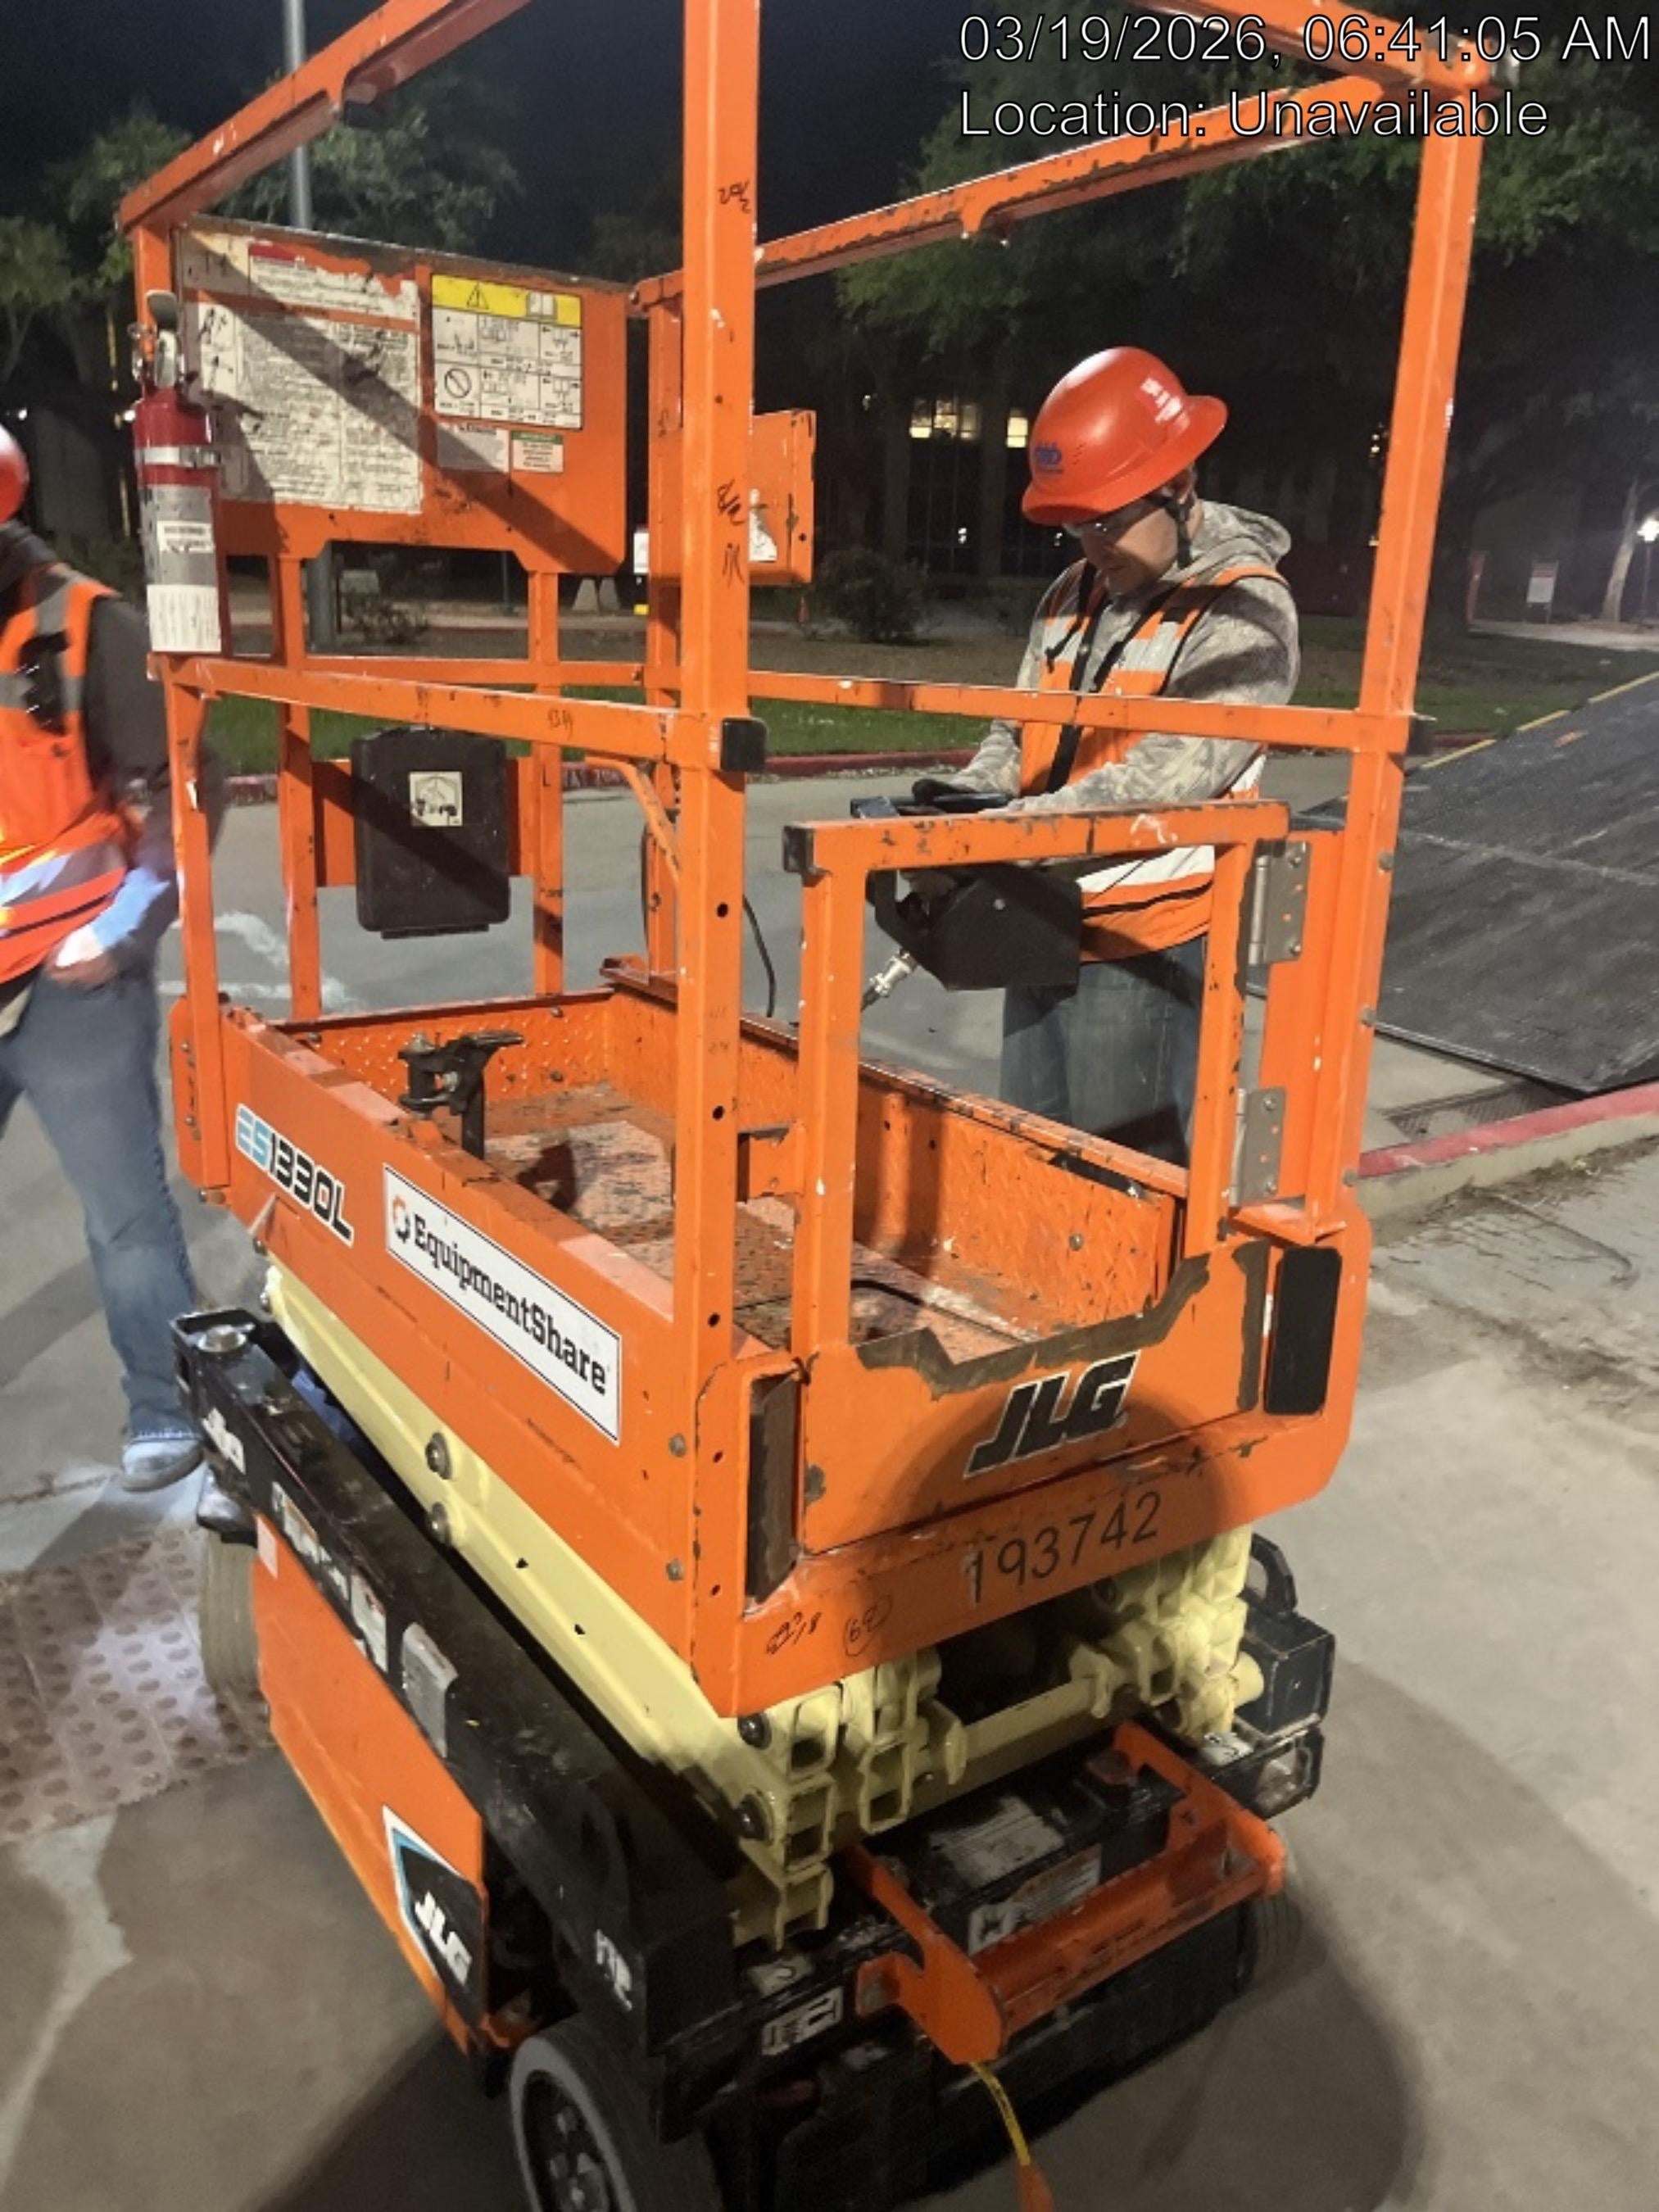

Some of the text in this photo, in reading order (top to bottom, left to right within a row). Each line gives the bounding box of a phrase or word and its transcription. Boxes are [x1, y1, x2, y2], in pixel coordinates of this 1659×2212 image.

[413, 1214, 607, 1395] EquipmentShare
[966, 1353, 1139, 1477] JLG
[968, 1493, 1159, 1603] 193742
[414, 1891, 473, 1985] JLG
